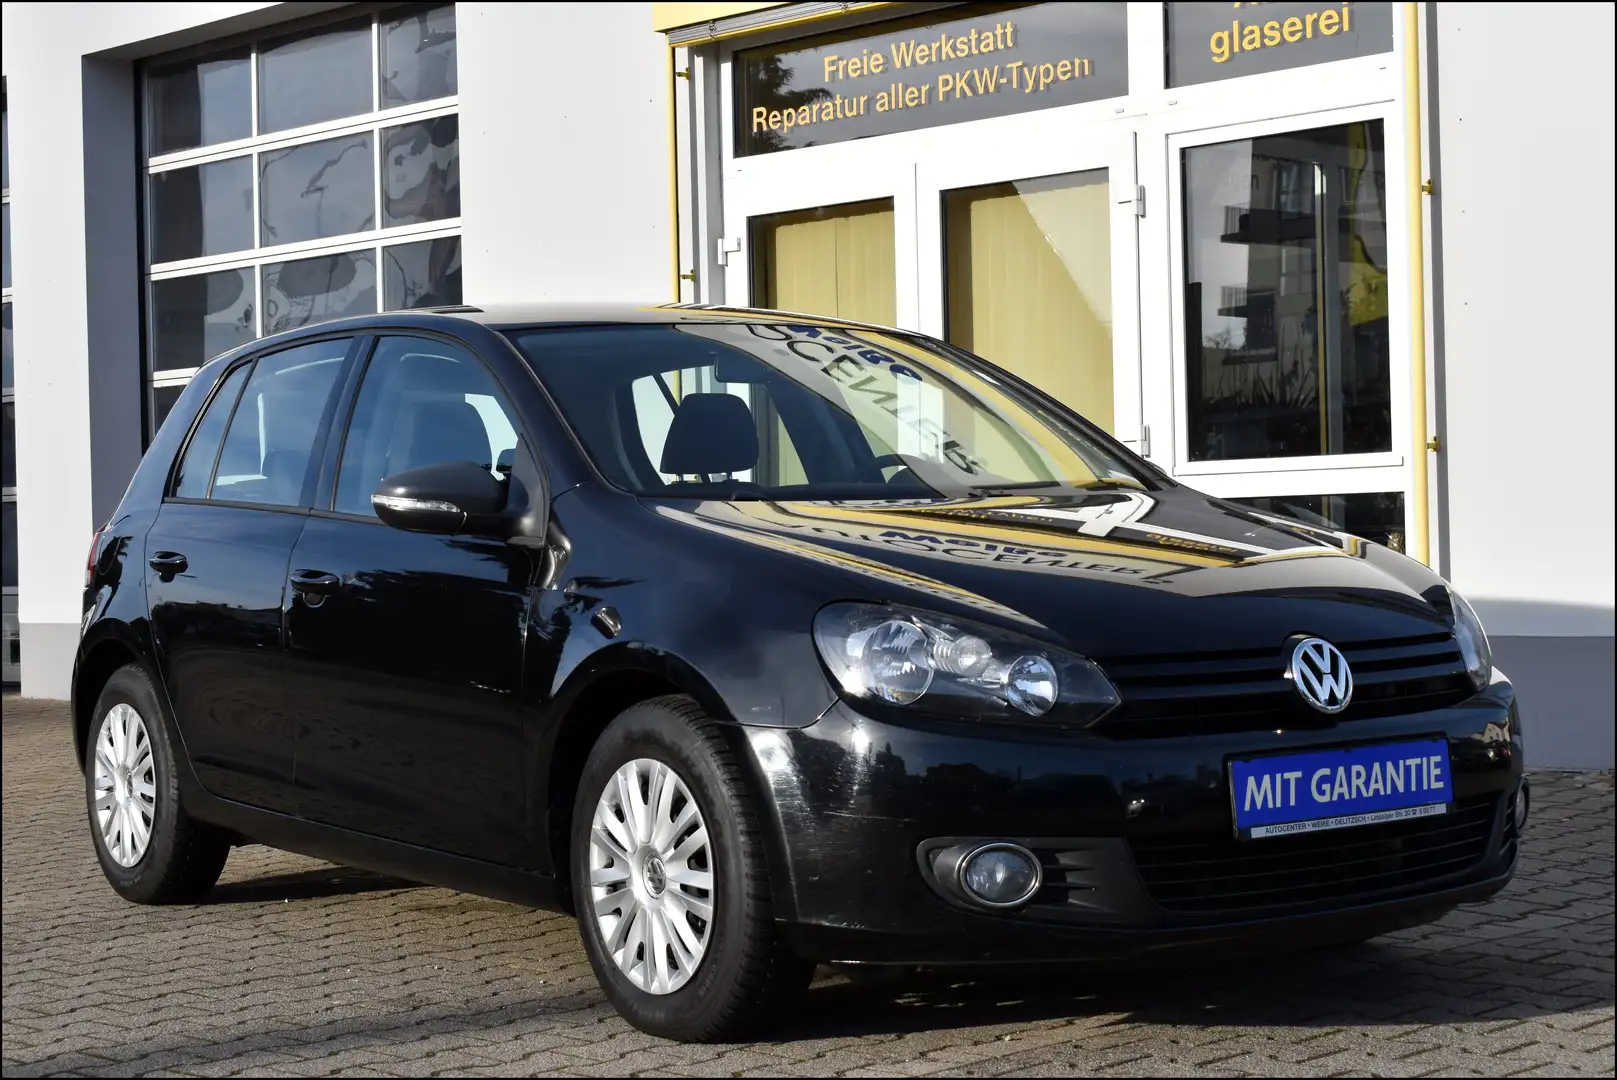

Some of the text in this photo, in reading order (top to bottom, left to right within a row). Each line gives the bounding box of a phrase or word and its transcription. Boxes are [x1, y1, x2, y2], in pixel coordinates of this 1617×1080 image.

[823, 22, 1015, 83] Freie Werkstatt
[1210, 2, 1349, 63] glaserei
[752, 56, 1092, 133] Reparatur aller PKW-Typen
[1244, 755, 1444, 812] MIT GARANTIE
[1265, 822, 1307, 834] AUTOCENTER
[1335, 815, 1367, 826] DELITZSCH
